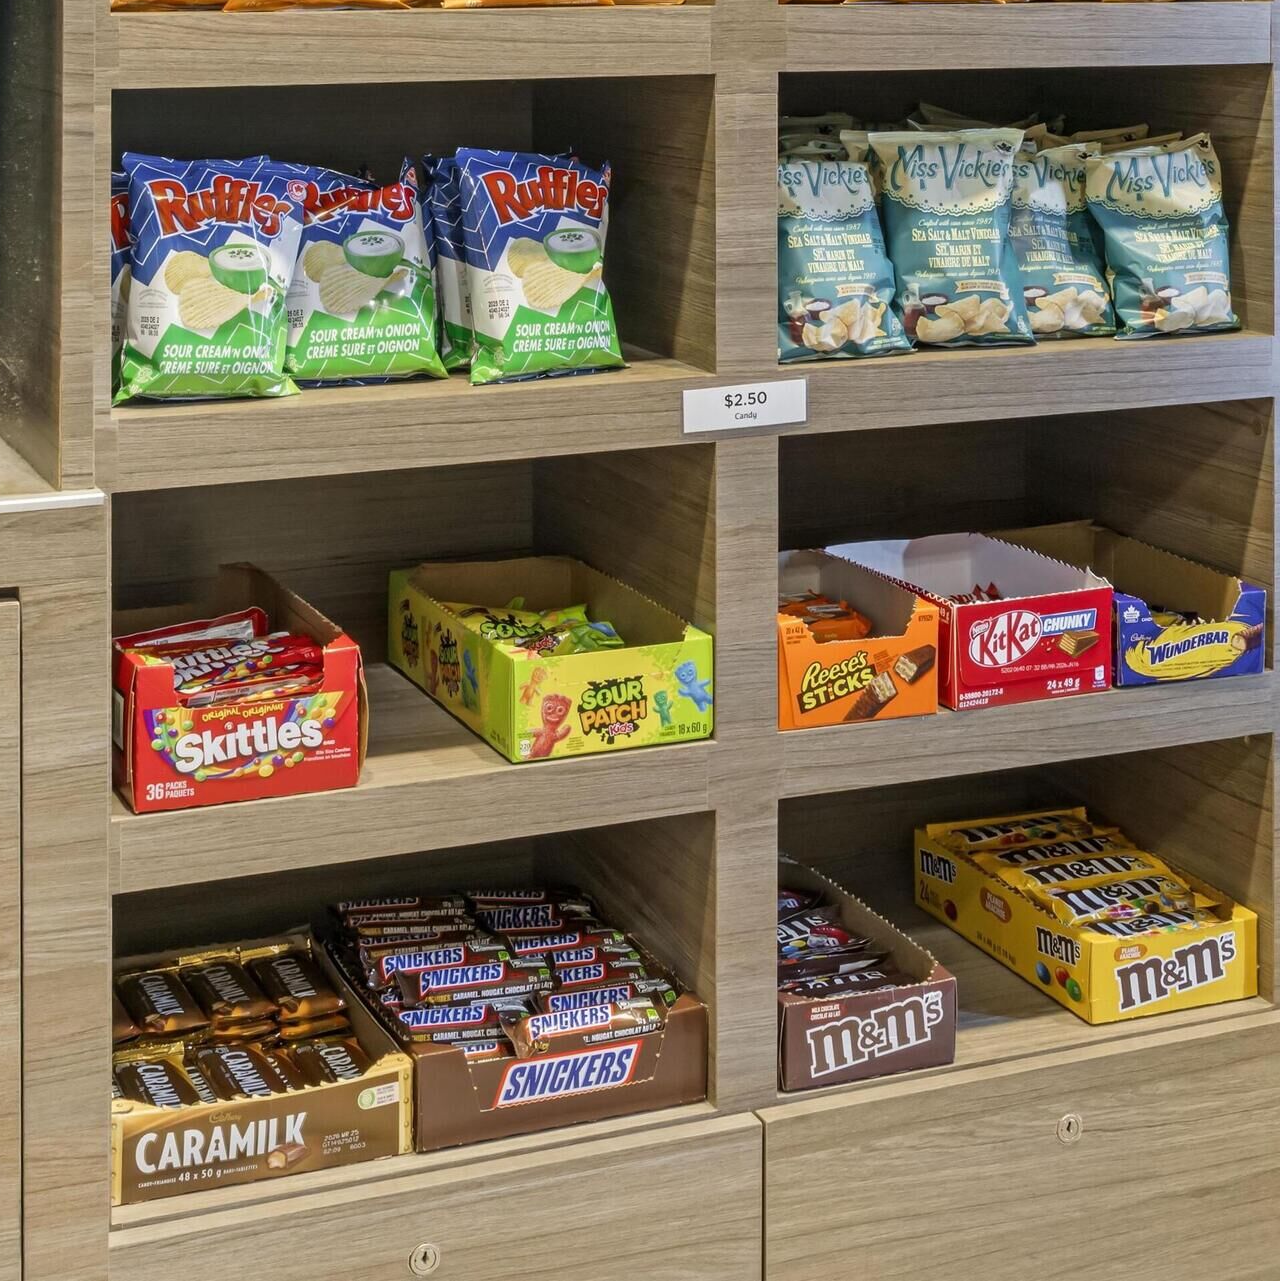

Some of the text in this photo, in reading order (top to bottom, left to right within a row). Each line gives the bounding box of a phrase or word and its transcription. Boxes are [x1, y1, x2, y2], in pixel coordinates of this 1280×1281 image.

[891, 144, 1010, 191] Miss Vickie's
[149, 175, 292, 238] Ruffles
[480, 166, 607, 227] Ruffles
[928, 228, 944, 240] SALT
[952, 228, 970, 240] MALT
[310, 329, 338, 343] SOUR
[385, 323, 420, 338] ONION
[516, 325, 540, 336] SOUR
[584, 321, 610, 331] ONION
[342, 343, 365, 356] SURE
[377, 339, 420, 353] OIGNON
[545, 338, 566, 350] SURE
[577, 336, 611, 348] OIGNON
[724, 391, 767, 408] $2.50
[735, 412, 757, 420] Candy
[1044, 613, 1090, 632] CHUNKY
[1147, 631, 1230, 665] WUNDERBAR
[801, 650, 868, 692] Reese's
[1047, 681, 1056, 689] 24
[1064, 679, 1073, 687] 49
[581, 679, 643, 709] SOUR
[580, 702, 647, 732] PATCH
[608, 722, 634, 737] Kids
[175, 717, 322, 773] Skittles
[146, 782, 164, 801] 36
[165, 780, 187, 790] PACKS
[165, 788, 194, 798] PAQUETS
[1036, 926, 1081, 966] m&m's
[1121, 946, 1141, 954] PEANUT
[384, 949, 462, 975] SNICKERS
[1115, 932, 1236, 1012] m&m's
[205, 967, 250, 1004] CARAMILK
[272, 958, 316, 998] CARAMILK
[421, 964, 502, 991] SNICKERS
[505, 985, 533, 995] CHOCOLAT
[139, 975, 184, 1015] CARAMILK
[550, 988, 628, 1011] SNICKERS
[400, 1006, 483, 1025] SNICKERS
[531, 1006, 610, 1039] SNICKERS
[807, 991, 944, 1078] m&m's
[503, 1046, 636, 1102] SNICKERS
[135, 1112, 308, 1174] CARAMILK
[179, 1171, 190, 1182] 48
[201, 1169, 213, 1179] 50
